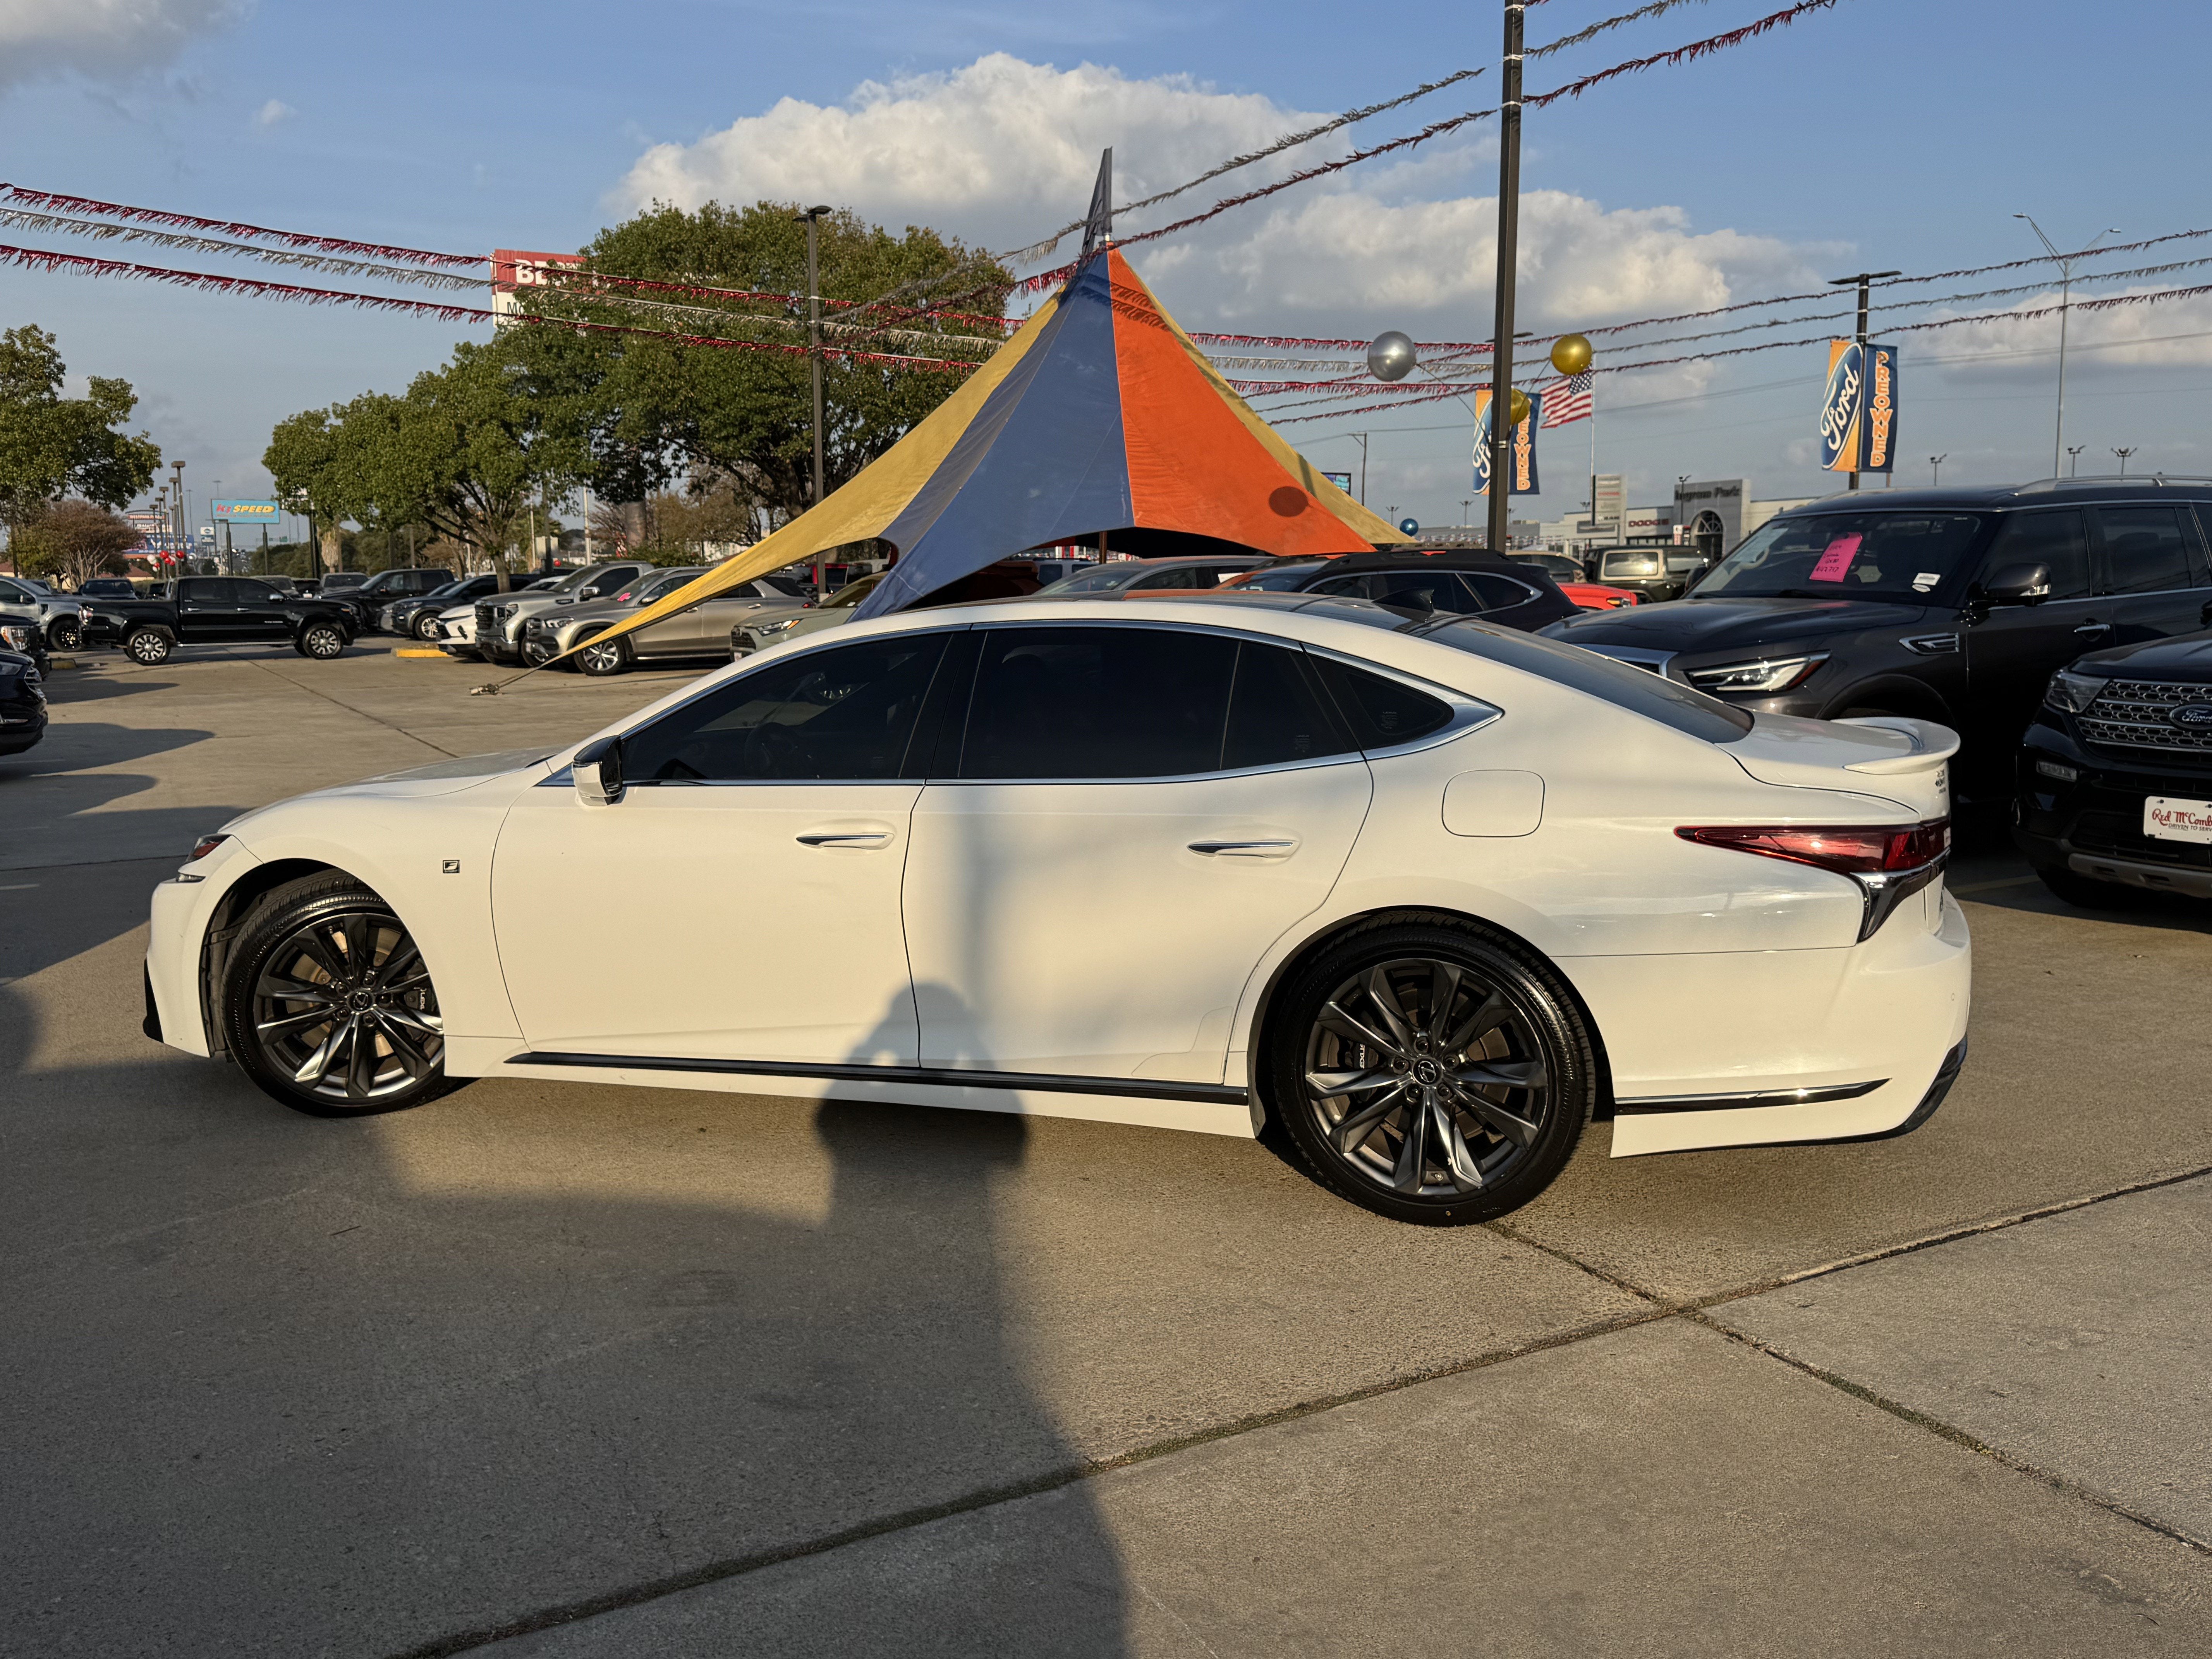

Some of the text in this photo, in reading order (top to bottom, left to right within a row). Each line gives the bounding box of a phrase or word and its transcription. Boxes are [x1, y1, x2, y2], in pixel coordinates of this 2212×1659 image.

[1820, 363, 1859, 450] Ford
[1869, 351, 1893, 467] PREOWNED
[233, 505, 275, 514] SPEED
[1628, 519, 1669, 527] DODGE
[2152, 808, 2212, 826] Red McComb
